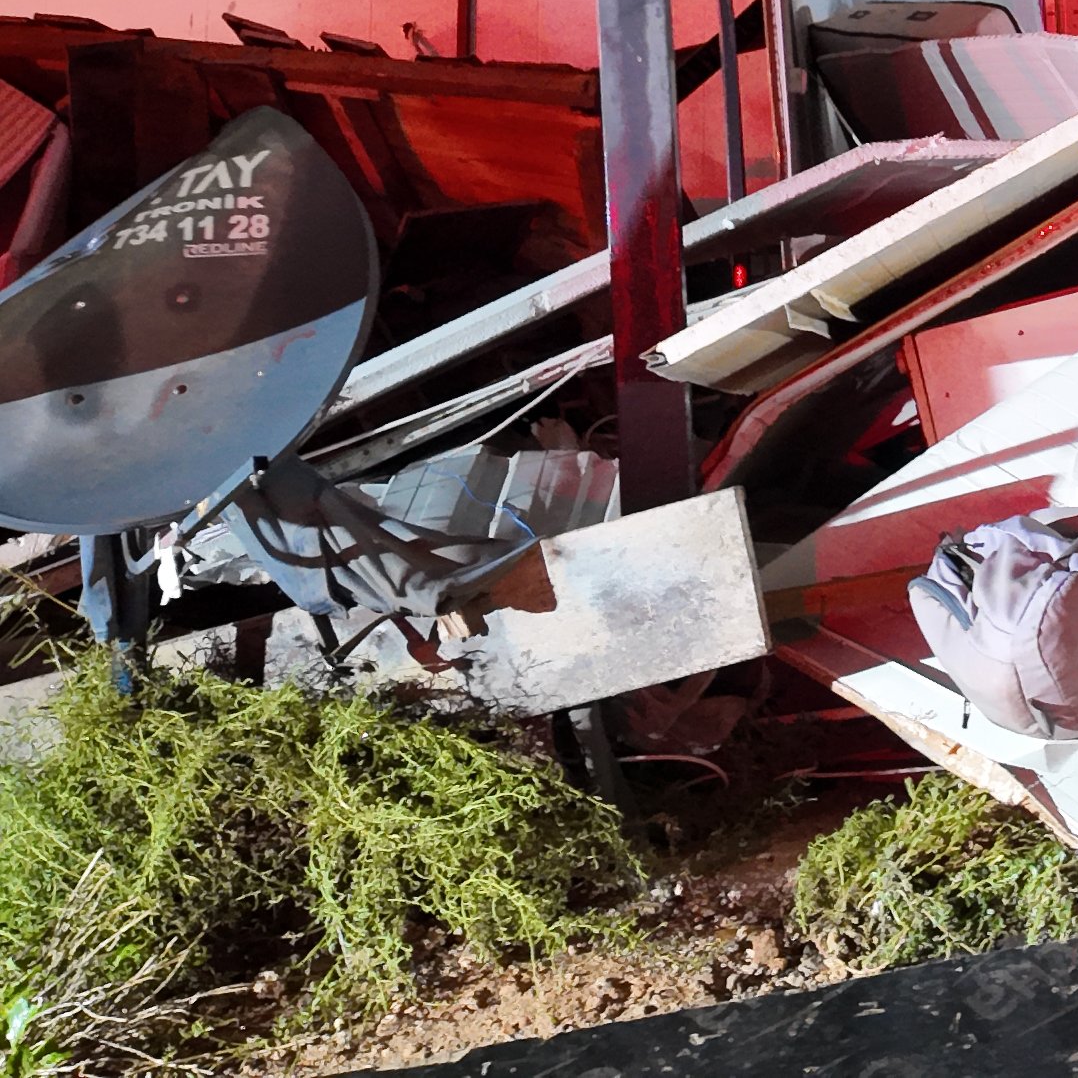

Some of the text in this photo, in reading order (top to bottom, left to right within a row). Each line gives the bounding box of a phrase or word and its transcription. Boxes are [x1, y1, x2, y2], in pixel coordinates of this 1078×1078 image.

[151, 150, 271, 205] TAY
[113, 215, 270, 250] 734 11 28
[183, 241, 268, 257] REDLINE
